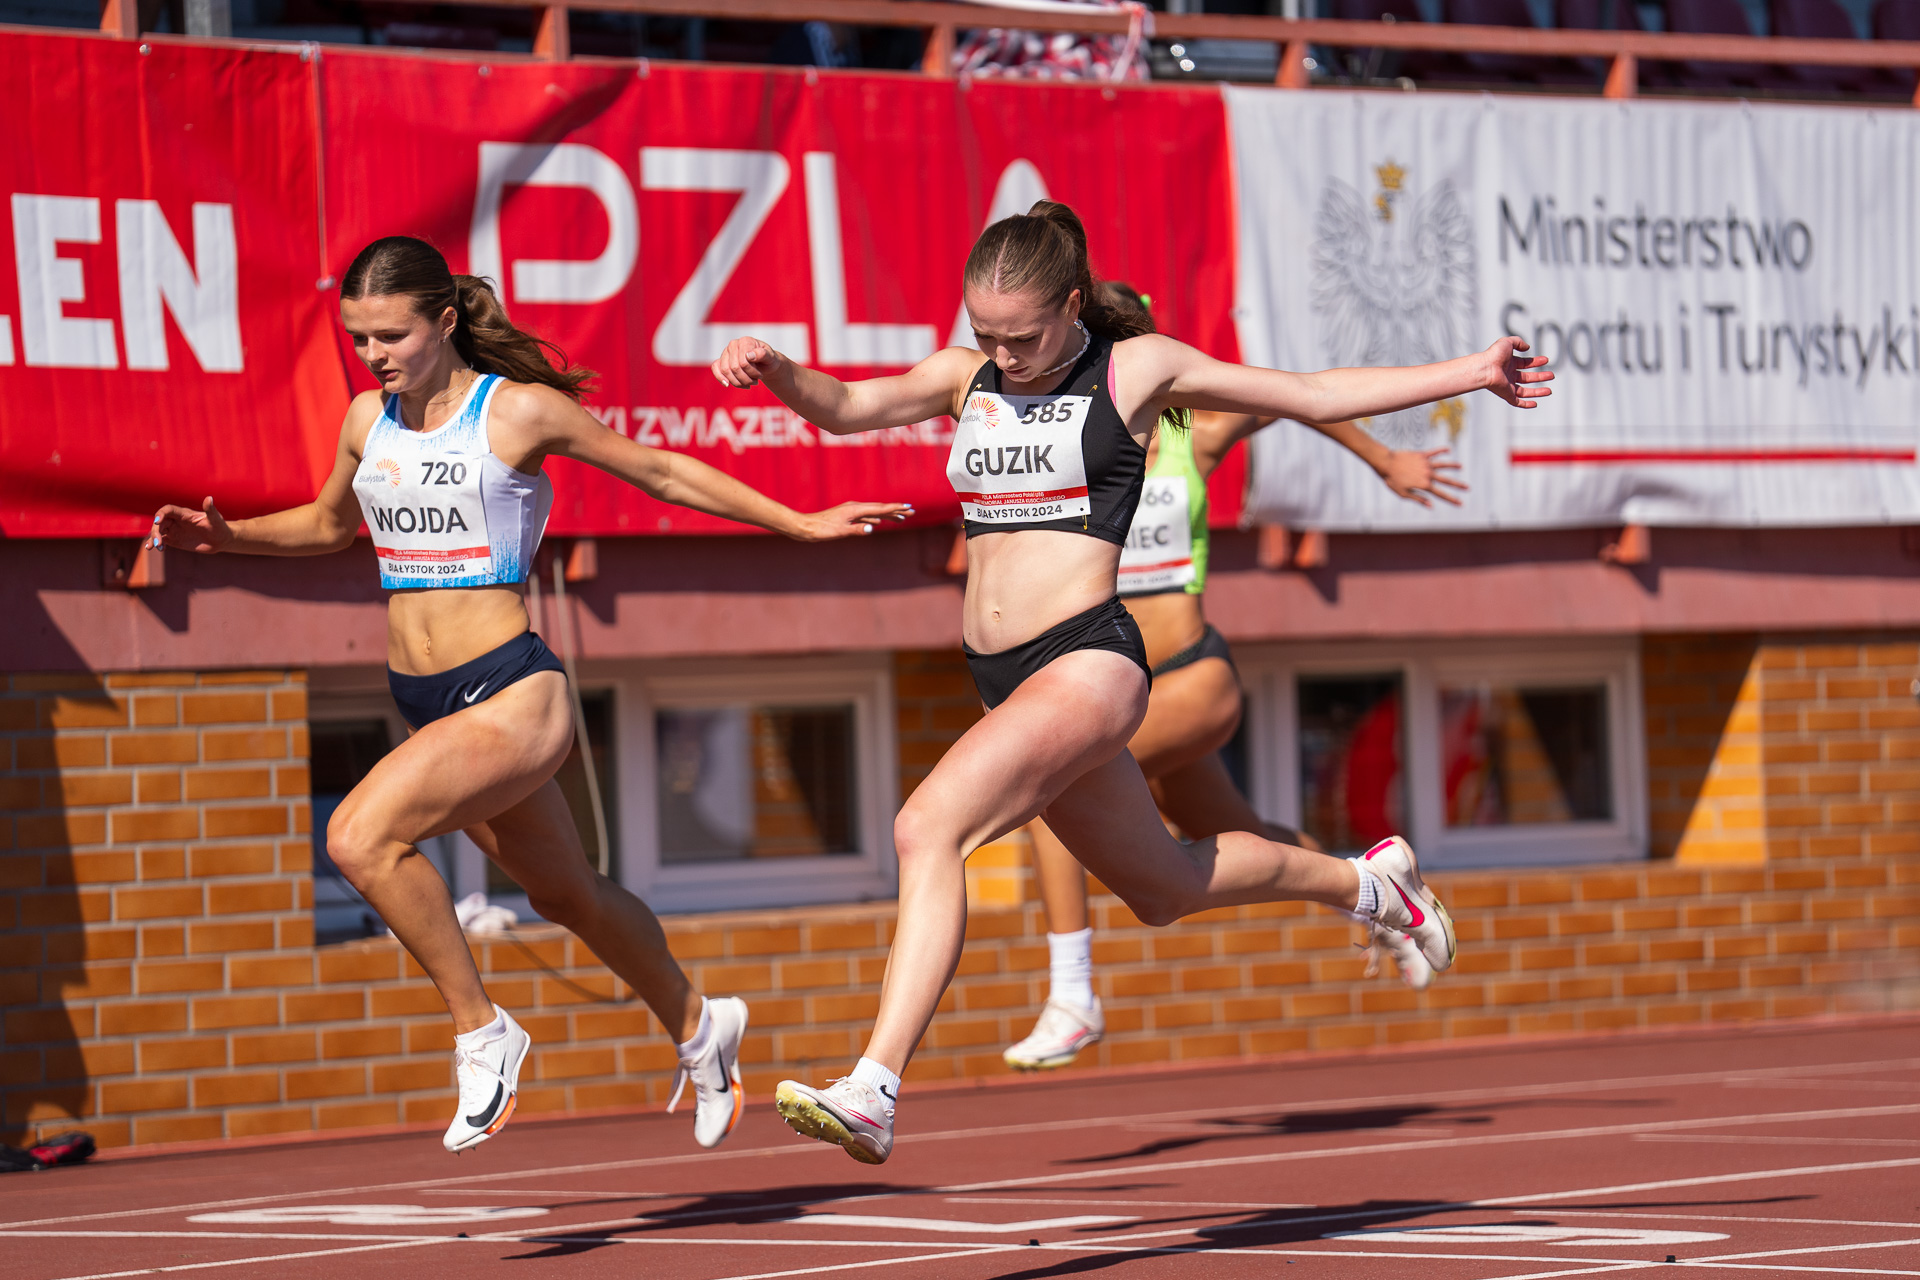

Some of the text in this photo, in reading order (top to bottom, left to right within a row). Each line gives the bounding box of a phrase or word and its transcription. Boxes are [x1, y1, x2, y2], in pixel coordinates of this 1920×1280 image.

[1498, 194, 1814, 272] Ministerstwo
[0, 193, 244, 373] EN
[1678, 302, 1692, 374] i
[1703, 302, 1920, 392] Turystyki
[1020, 402, 1075, 425] 585
[965, 444, 1056, 477] GUZIK
[421, 461, 467, 486] 720
[1143, 485, 1175, 506] 66
[371, 505, 469, 534] WOJDA
[977, 504, 1063, 519] BIAŁYSTOK 2024
[1123, 525, 1169, 550] IEC
[389, 562, 466, 575] BIAŁYSTOK 2024
